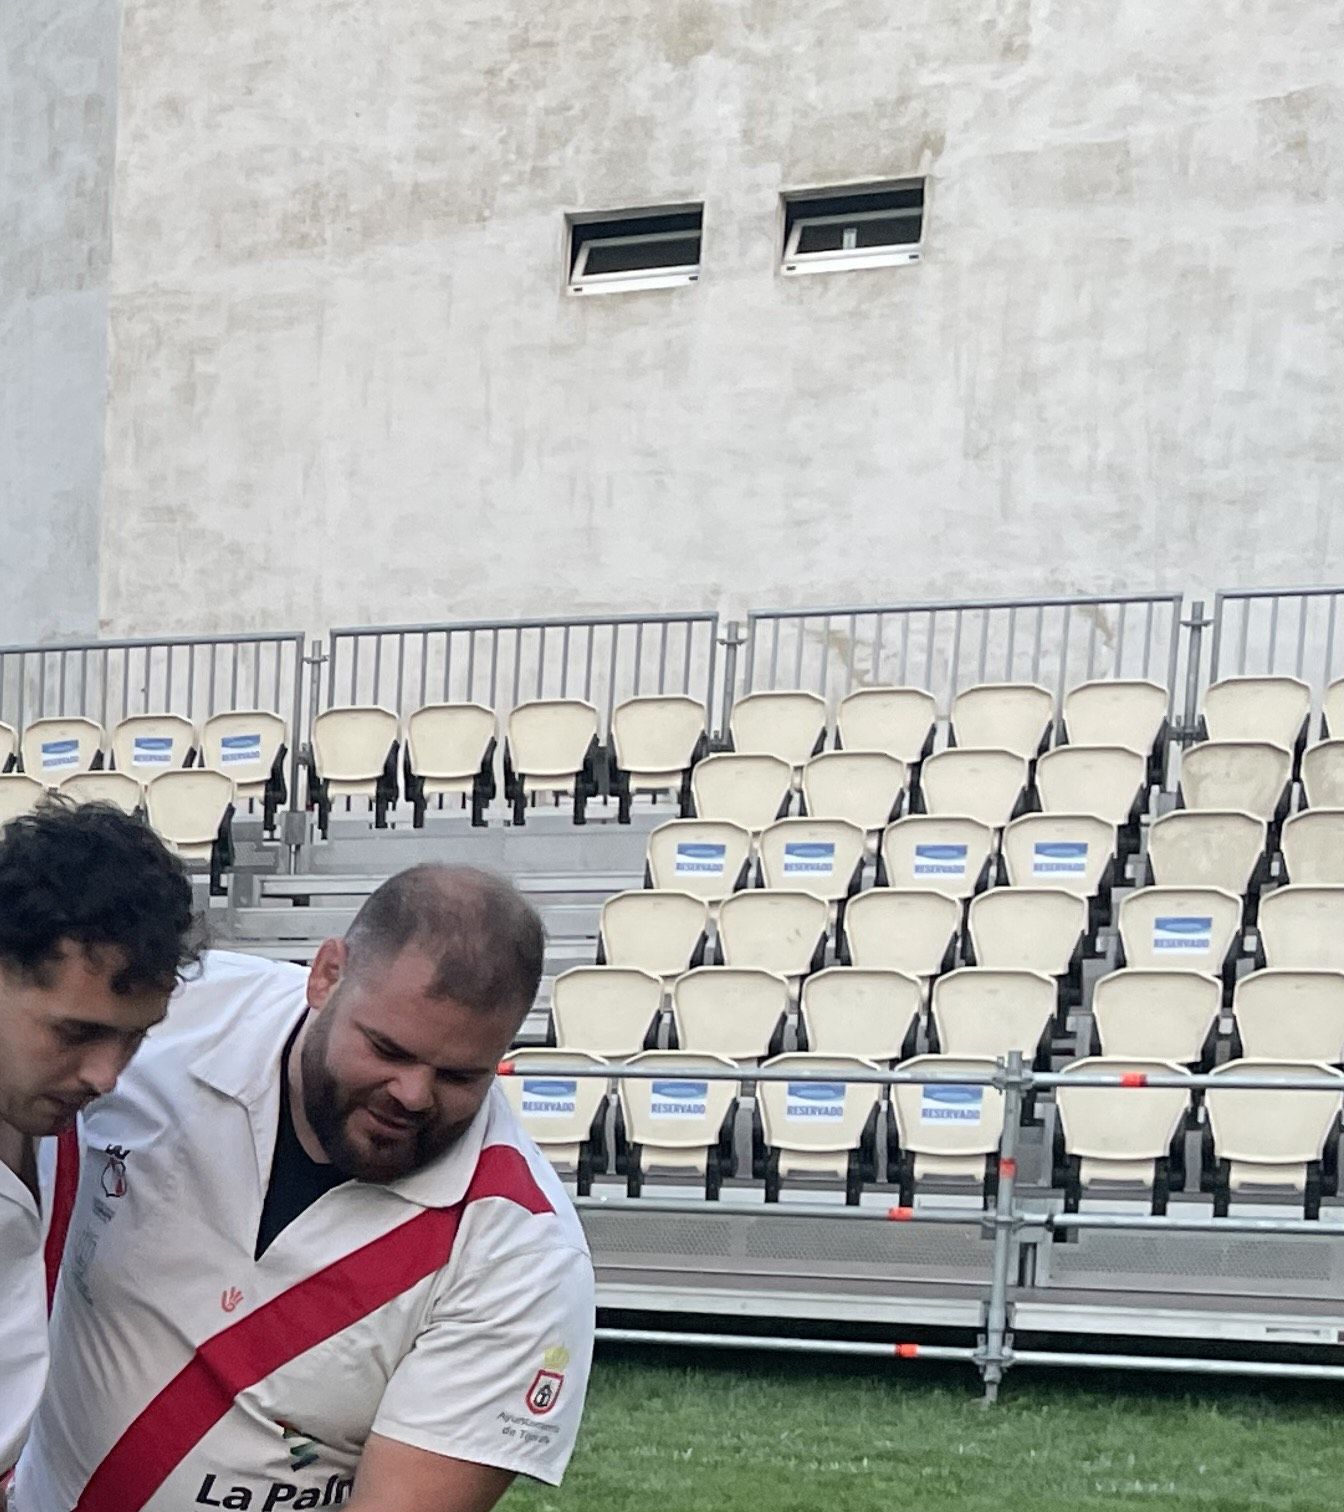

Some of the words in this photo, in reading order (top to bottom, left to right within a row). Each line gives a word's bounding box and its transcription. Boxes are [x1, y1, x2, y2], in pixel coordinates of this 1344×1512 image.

[521, 1101, 575, 1113] RESERVADO
[650, 1103, 706, 1115] RESERVADO
[786, 1105, 844, 1118] RESERVADO
[921, 1108, 981, 1120] RESERVADO
[194, 1473, 254, 1511] La
